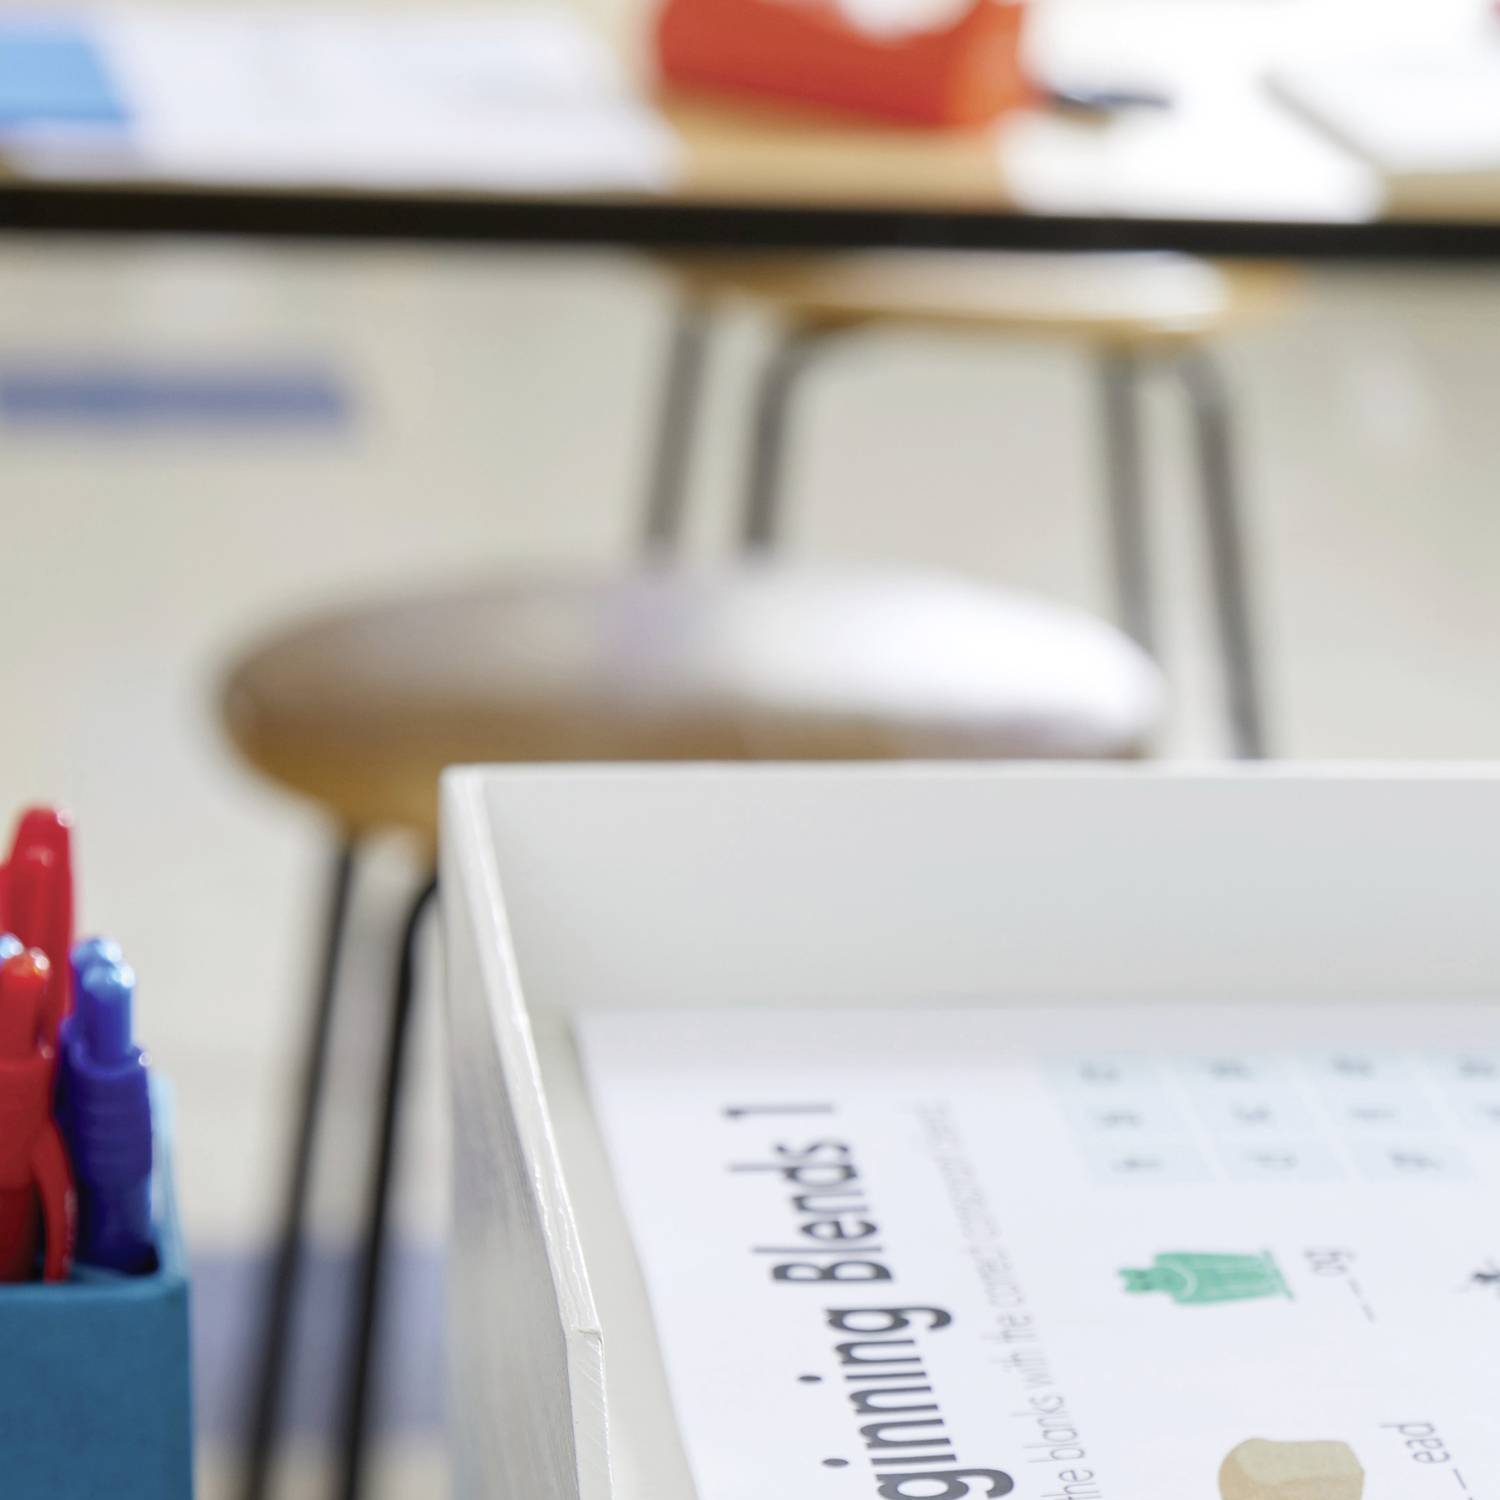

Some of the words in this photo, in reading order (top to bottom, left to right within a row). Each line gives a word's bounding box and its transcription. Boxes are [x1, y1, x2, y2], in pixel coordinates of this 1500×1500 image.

[720, 1103, 834, 1119] 1
[726, 1140, 894, 1284] Blends
[1009, 1394, 1086, 1464] blanks
[1381, 1418, 1450, 1466] ead
